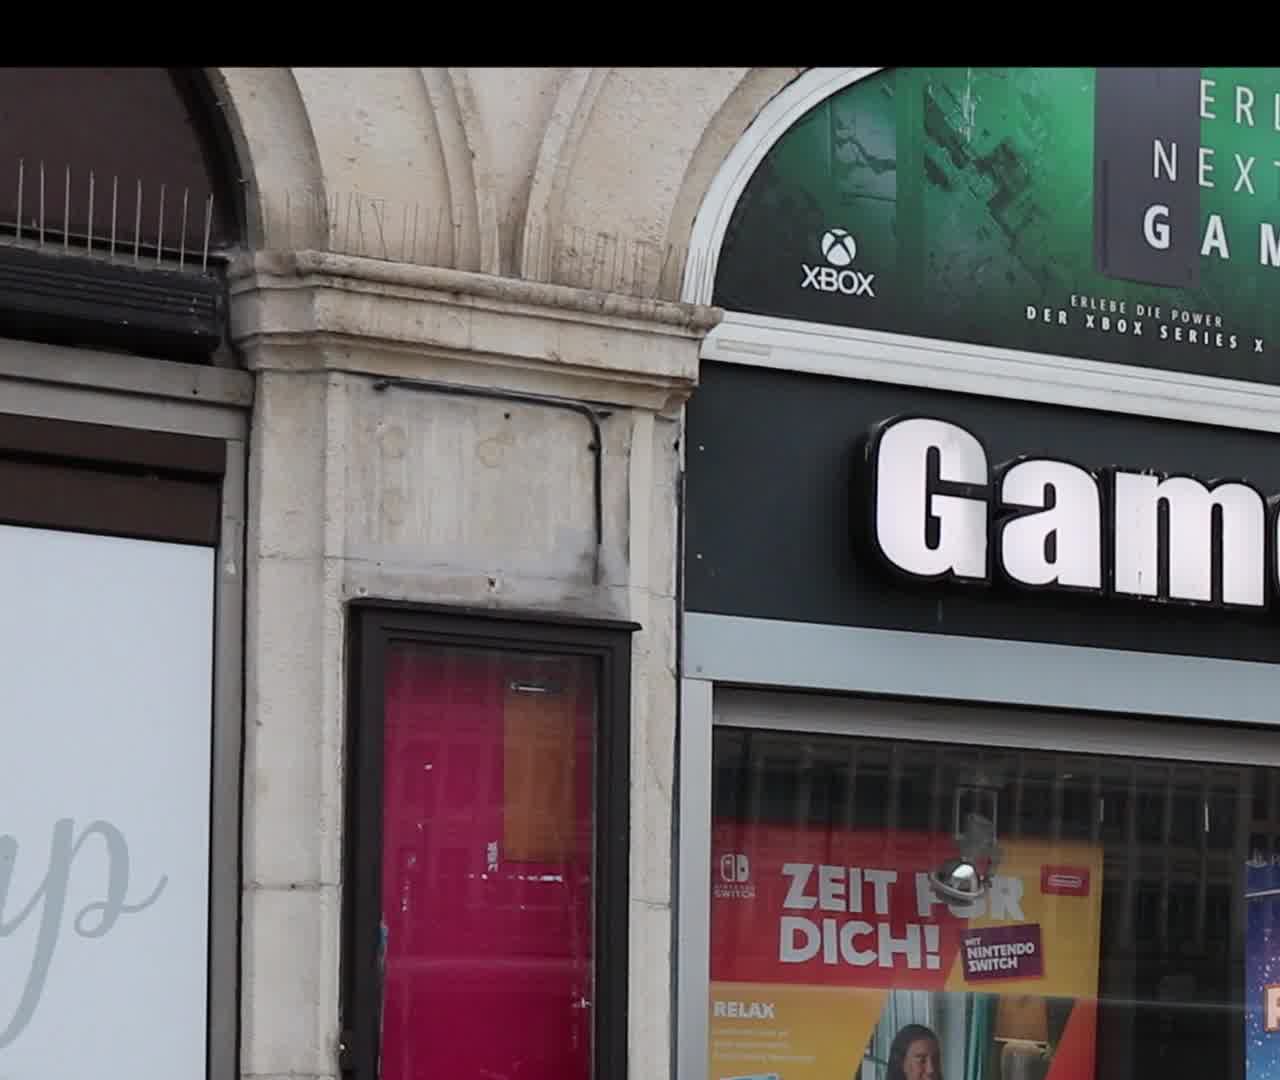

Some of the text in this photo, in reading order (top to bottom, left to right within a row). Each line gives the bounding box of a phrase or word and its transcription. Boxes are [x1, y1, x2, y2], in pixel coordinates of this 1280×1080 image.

[801, 263, 876, 298] XBOX
[1071, 294, 1222, 327] ERLEBE DIE POWER
[1026, 305, 1263, 352] DER XBOX SERIES X
[782, 863, 1024, 921] ZEIT FR
[779, 915, 941, 970] DICH!
[967, 942, 1035, 959] NINTENDO
[968, 957, 1018, 972] SWITCH
[714, 1001, 776, 1018] RELAX
